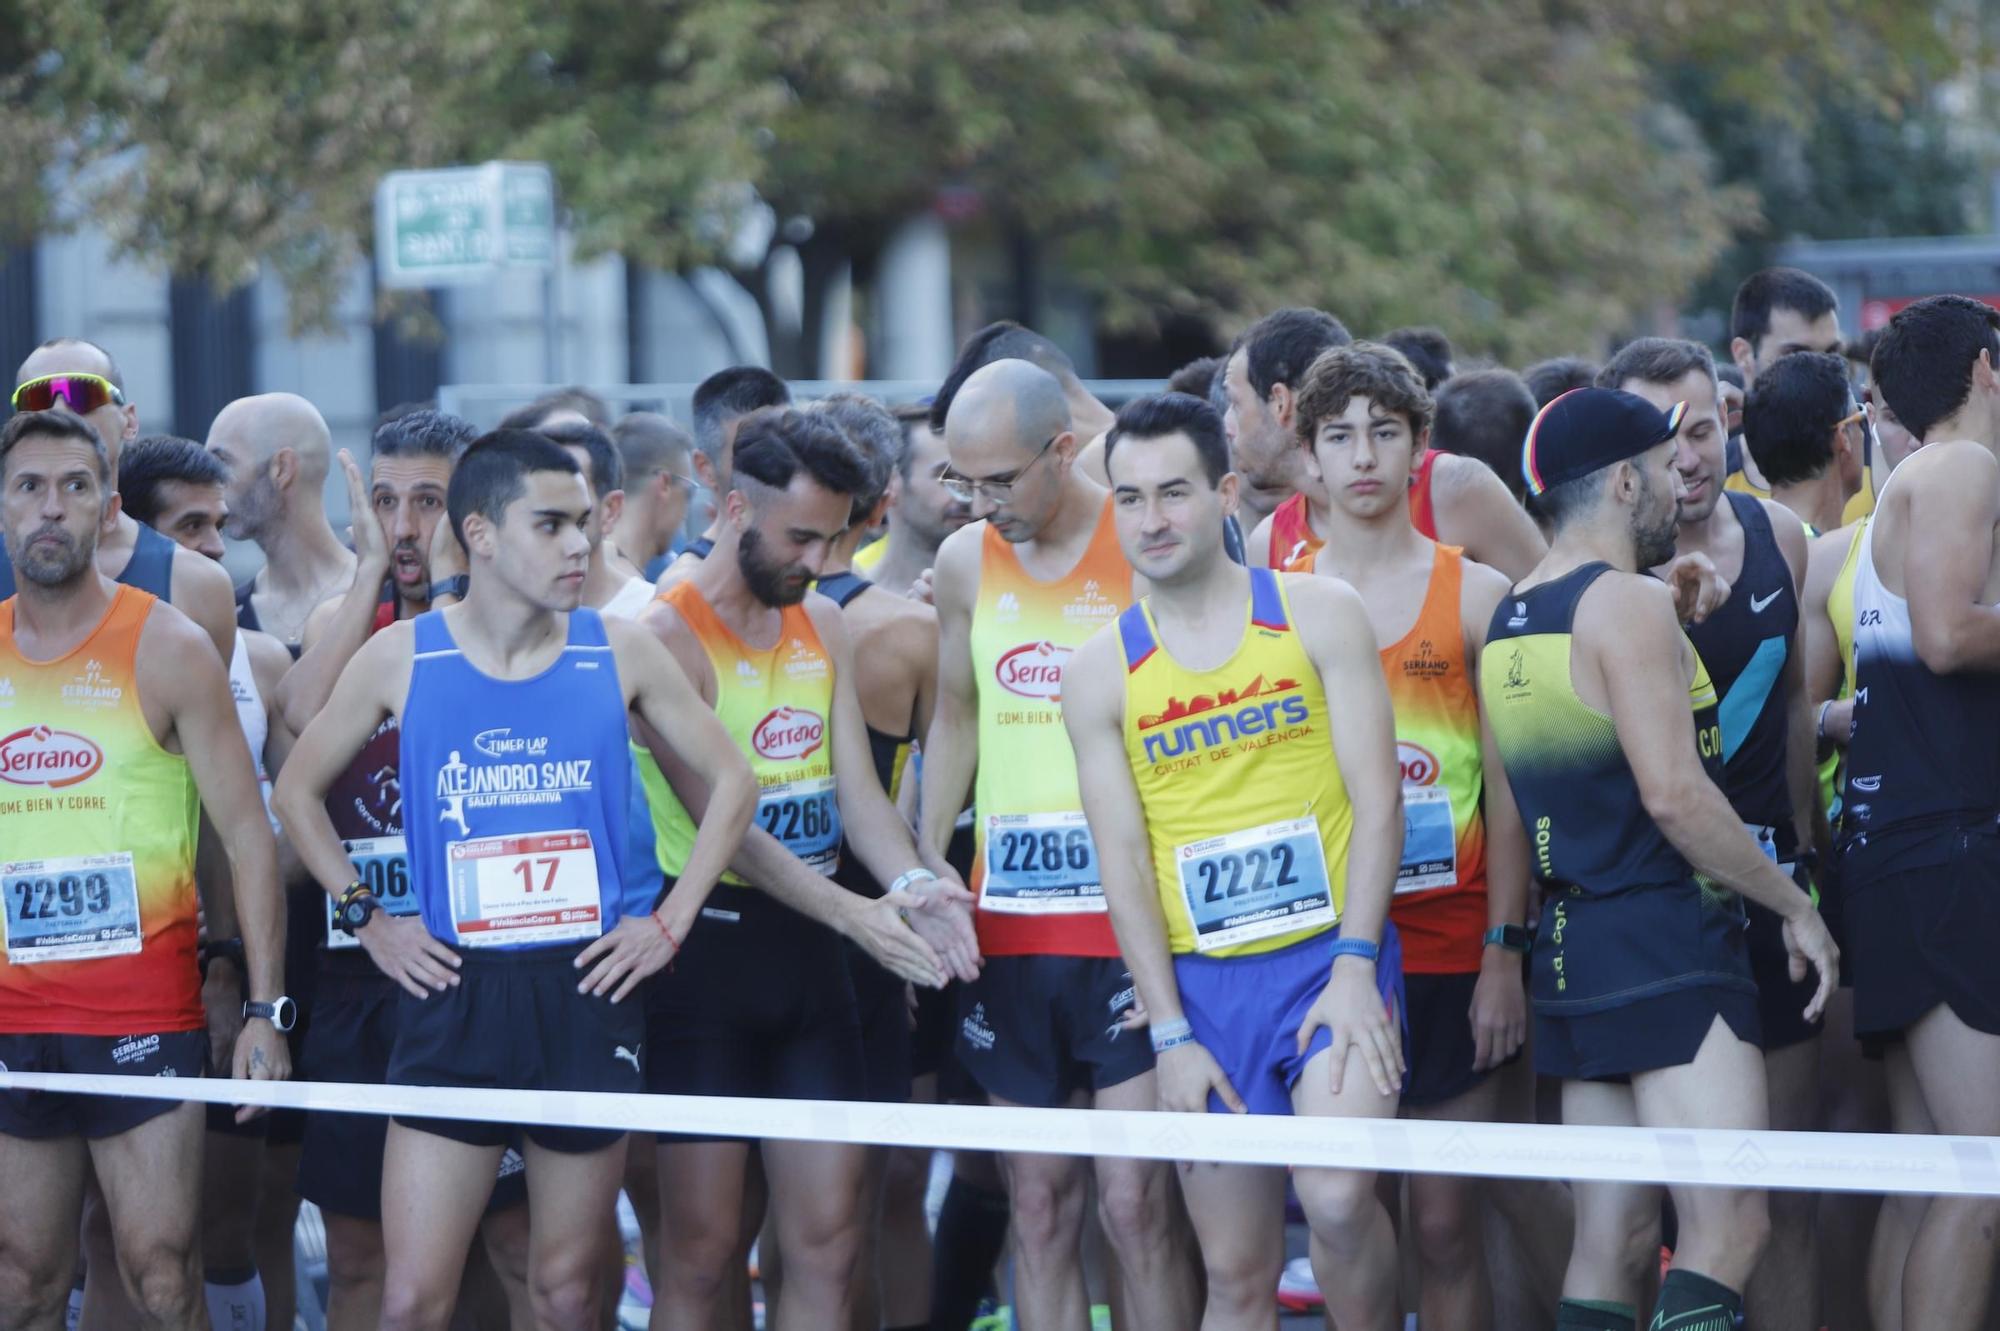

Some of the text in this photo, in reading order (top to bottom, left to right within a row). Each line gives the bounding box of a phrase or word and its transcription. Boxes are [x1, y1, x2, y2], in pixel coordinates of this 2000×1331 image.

[1007, 658, 1061, 683] Serra
[1403, 660, 1449, 671] SERRANO
[62, 684, 122, 699] SERRANO
[1027, 711, 1052, 724] BIEN
[1144, 696, 1308, 763] runners
[489, 739, 525, 753] TIMER
[527, 736, 548, 750] LAP
[762, 724, 822, 751] Serrano
[1699, 725, 1722, 757] CO
[0, 746, 92, 772] Serrano
[1155, 757, 1202, 777] CIUTAT
[1210, 747, 1232, 762] DE
[437, 760, 592, 796] ALEJANDRO SANZ
[0, 796, 107, 815] OME BIEN Y CORRE
[468, 792, 562, 808] SALUT INTEGRATIVA
[763, 797, 831, 840] 2266
[1001, 829, 1090, 871] 2286
[513, 856, 561, 893] 17
[1199, 843, 1298, 903] 2222
[15, 873, 111, 920] 2299
[963, 1017, 995, 1042] SERRANO
[112, 1034, 160, 1059] SERRANO
